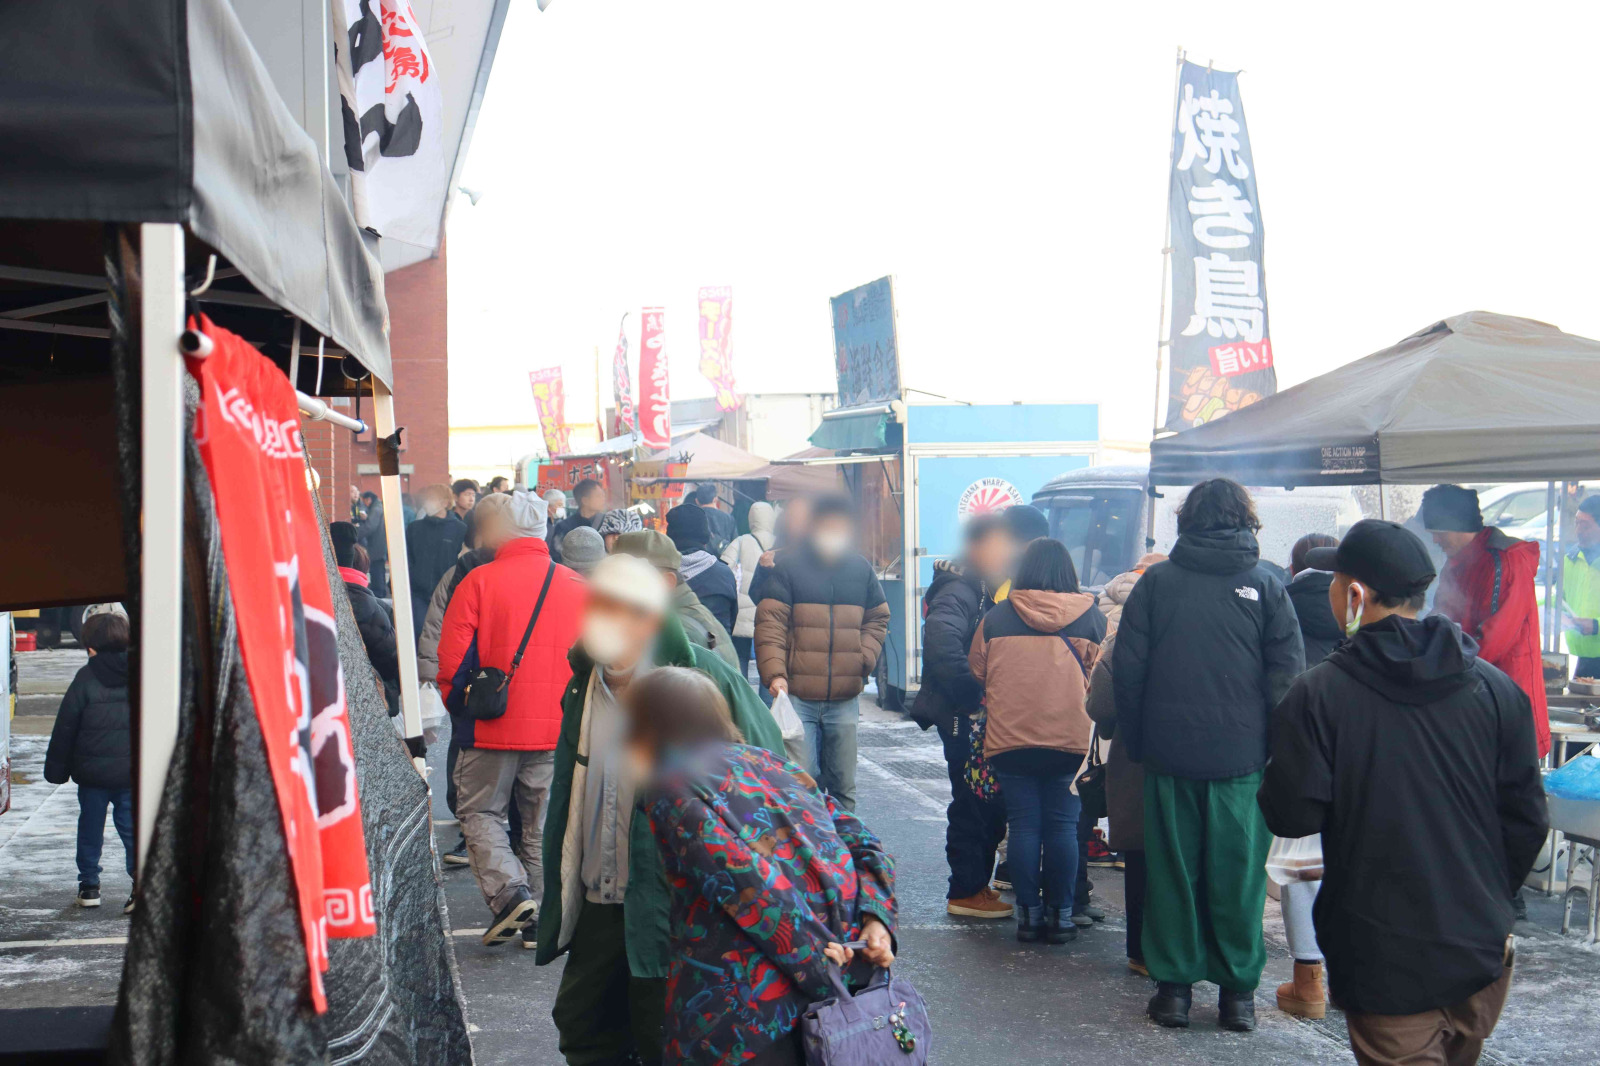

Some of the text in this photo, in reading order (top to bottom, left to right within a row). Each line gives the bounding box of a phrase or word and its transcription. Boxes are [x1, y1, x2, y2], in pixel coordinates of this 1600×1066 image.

[1177, 83, 1264, 345] 焼き鳥
[1215, 344, 1268, 375] 旨い!
[982, 479, 1006, 488] WHARF
